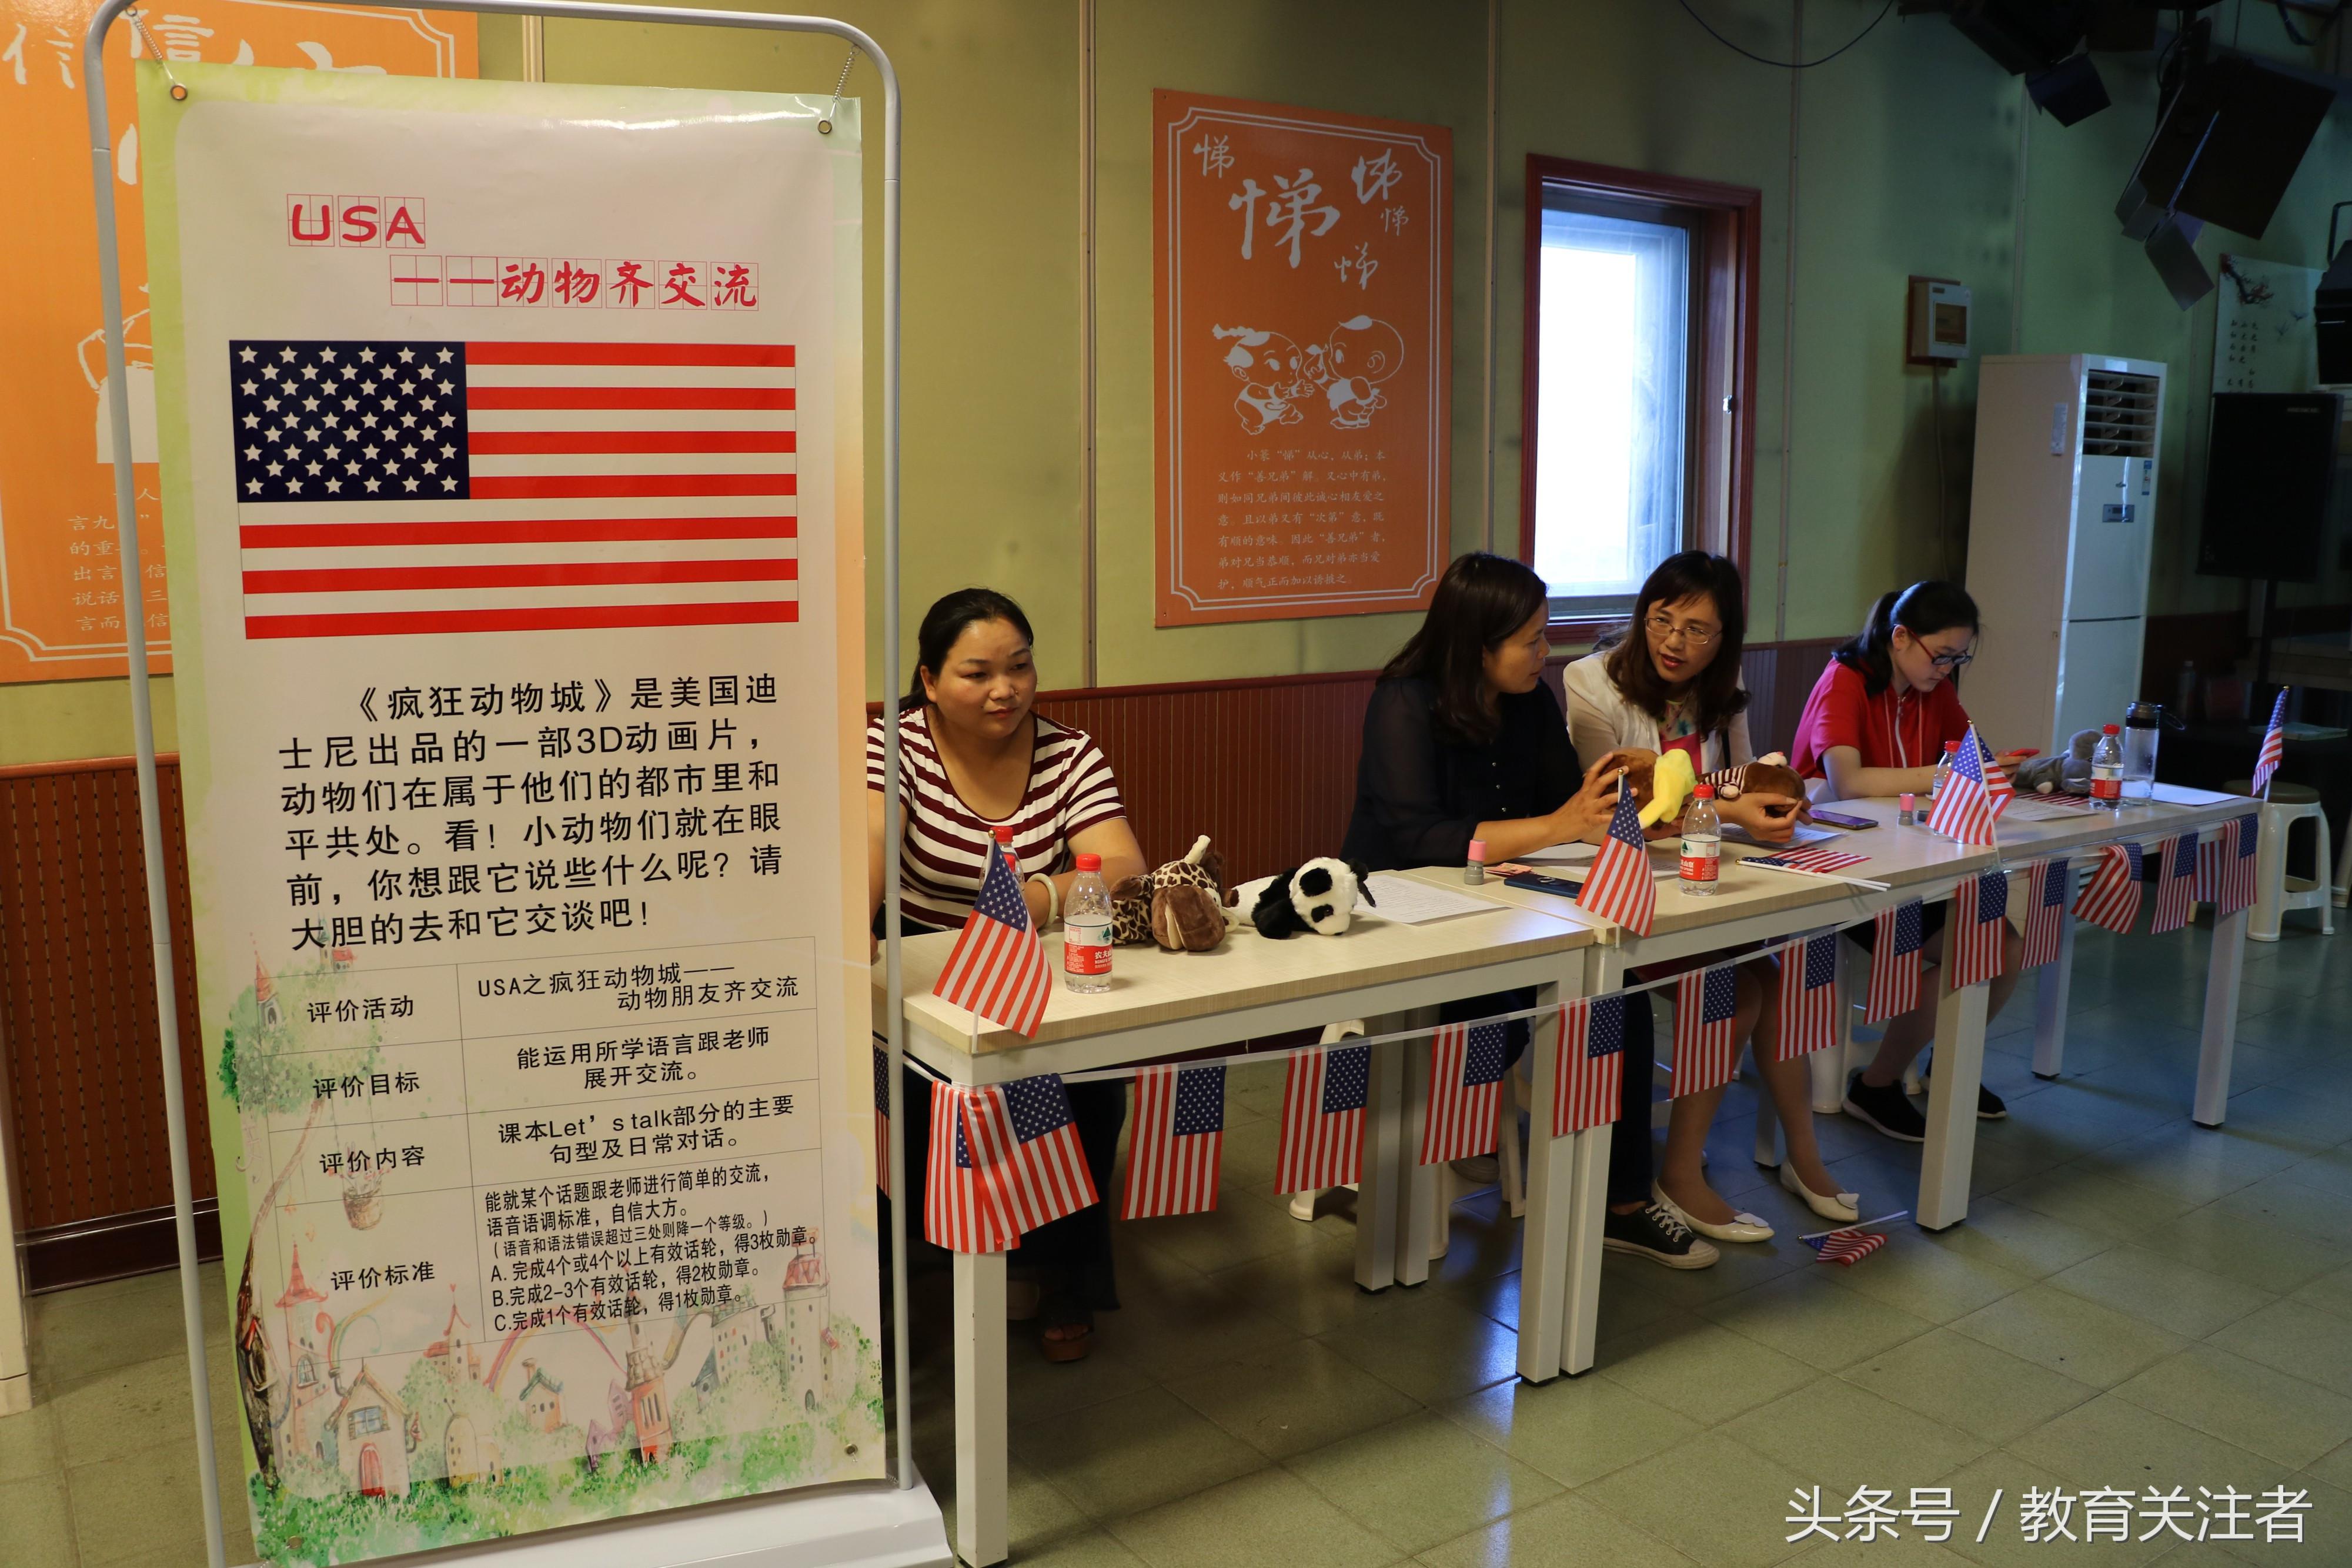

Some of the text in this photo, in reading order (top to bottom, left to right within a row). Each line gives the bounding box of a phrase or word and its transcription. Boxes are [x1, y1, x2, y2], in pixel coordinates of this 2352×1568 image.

[119, 8, 215, 62] 信
[1193, 133, 1234, 178] 悌
[290, 203, 426, 245] USA
[1228, 168, 1340, 268] 悌
[360, 673, 777, 722] 《疯狂动物城》是美国迪
[279, 718, 759, 769] 士尼出品的一部3D动画片，
[281, 760, 778, 815] 动物们在属于他们的都市里和
[292, 898, 648, 951] 大胆的去和它交谈吧！
[307, 995, 413, 1023] 评价活动
[617, 976, 798, 1011] 动物朋友齐交流
[517, 1027, 769, 1069] 能运用所学语言跟老师
[312, 1072, 420, 1099] 评价目标
[584, 1061, 697, 1089] 展开交流。
[319, 1146, 425, 1174] 评价内容
[550, 1127, 737, 1164] 句型及日常对话。
[485, 1163, 767, 1213] 能就某个话题跟老师进行简单的交流，
[487, 1198, 687, 1237] 语音语调标准，自信大方。
[330, 1261, 435, 1290] 评价标准
